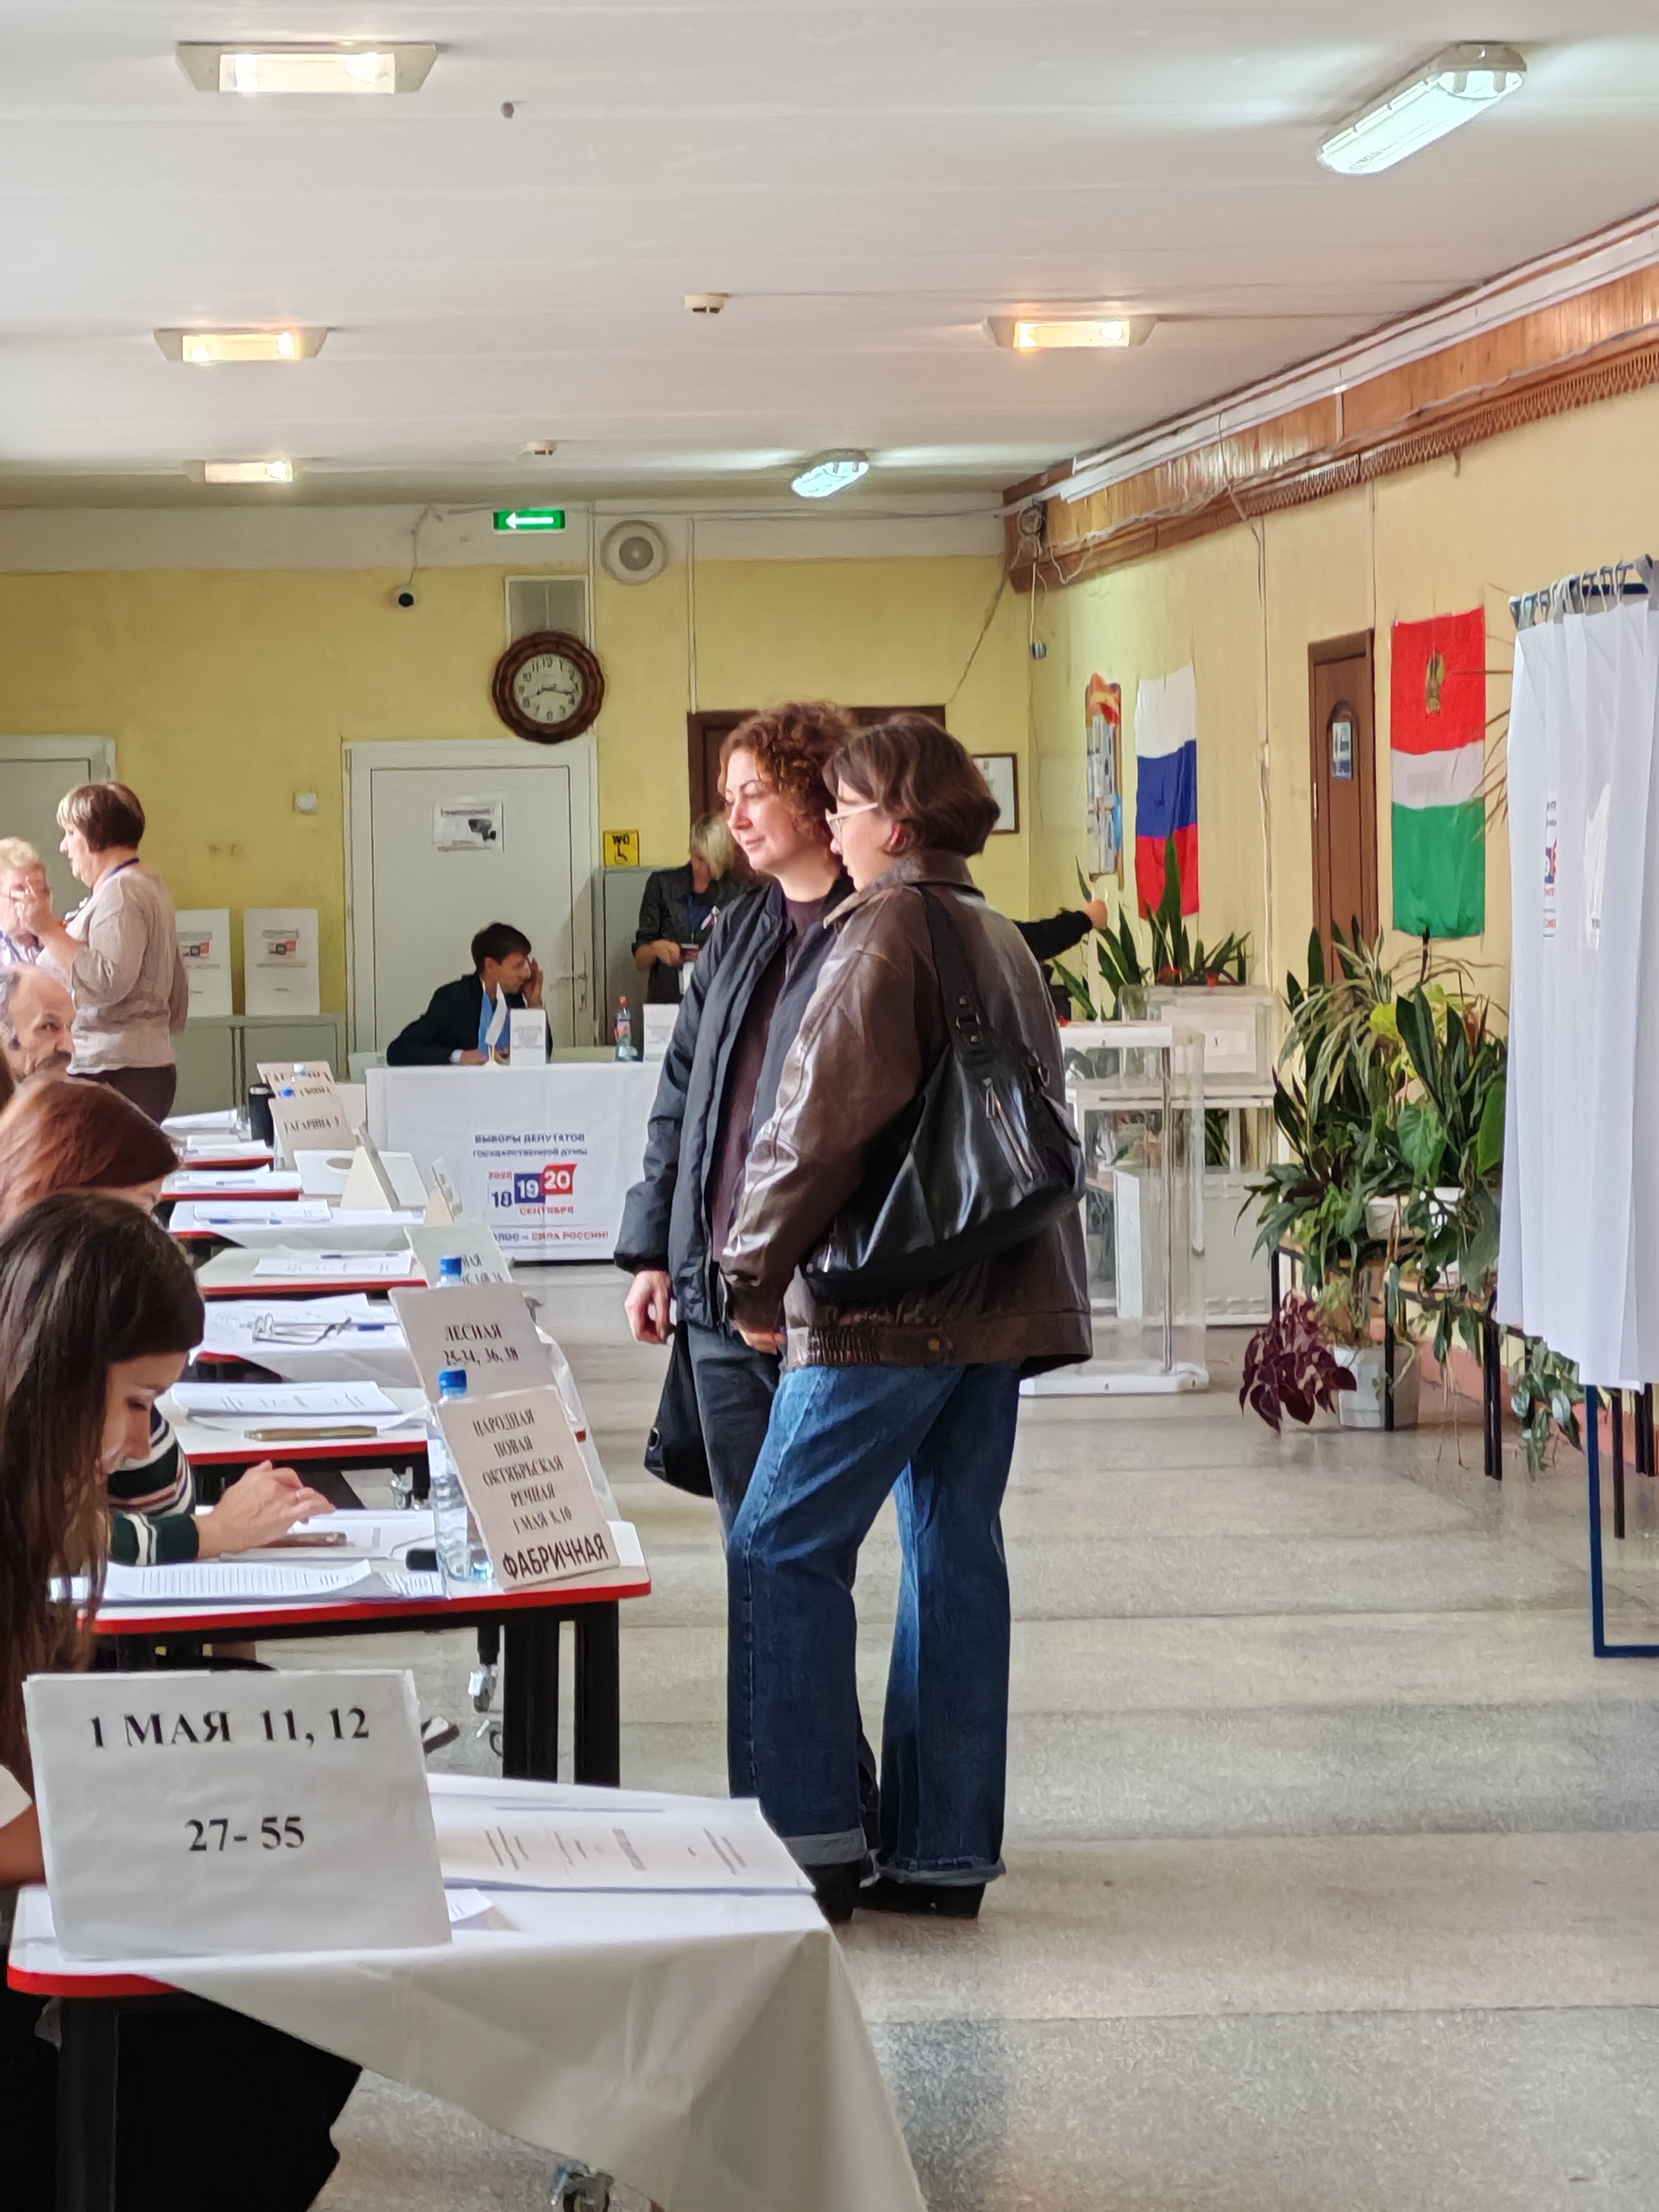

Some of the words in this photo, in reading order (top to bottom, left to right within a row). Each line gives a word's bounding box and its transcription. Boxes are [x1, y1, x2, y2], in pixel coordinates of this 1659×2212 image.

[491, 1191, 512, 1208] 18
[516, 1179, 539, 1199] 19
[544, 1170, 571, 1190] 20
[445, 1323, 502, 1342] ЛЕСНАЯ
[472, 1408, 536, 1437] НАРОДНАЯ
[493, 1435, 534, 1459] НОВАЯ
[482, 1454, 564, 1488] ОКТЯБРЬСКАЯ
[510, 1482, 556, 1508] РЕЧНАЯ
[519, 1510, 549, 1532] МАЯ
[502, 1532, 610, 1581] ФАБРИЧНАЯ
[89, 1715, 105, 1748] 1
[123, 1709, 232, 1748] МАЯ
[259, 1709, 314, 1748] 11,
[329, 1706, 370, 1741] 12
